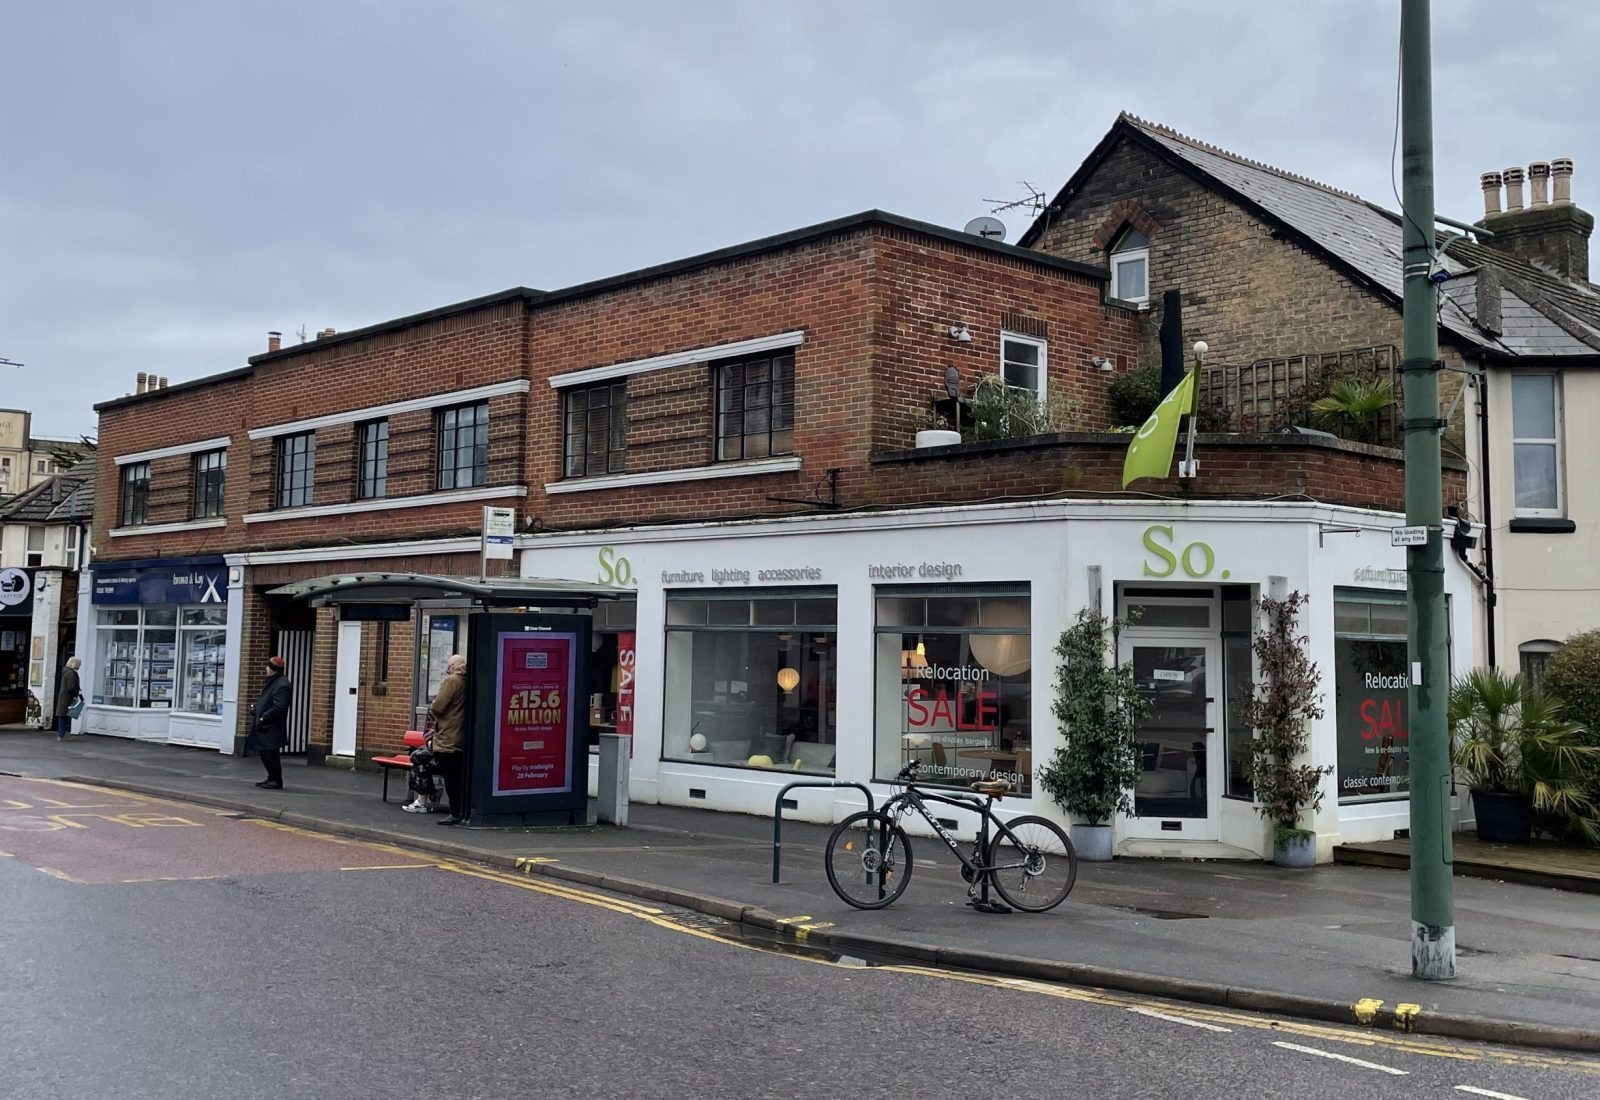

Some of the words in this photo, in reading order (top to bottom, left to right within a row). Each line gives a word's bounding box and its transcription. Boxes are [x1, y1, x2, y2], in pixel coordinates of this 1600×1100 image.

[1142, 525, 1231, 579] So.
[598, 545, 638, 586] So.
[661, 569, 705, 584] furniture
[711, 567, 751, 585] lighting
[757, 566, 822, 582] accessories
[868, 563, 915, 579] interior
[918, 562, 963, 581] design
[916, 663, 989, 681] Relocation
[619, 649, 635, 722] SALE
[510, 690, 560, 709] £15.6
[908, 688, 998, 732] SALE
[507, 709, 561, 725] MILLION
[1360, 698, 1409, 740] SAL
[917, 762, 987, 781] contemporary
[990, 768, 1025, 785] design
[1343, 775, 1368, 789] classic
